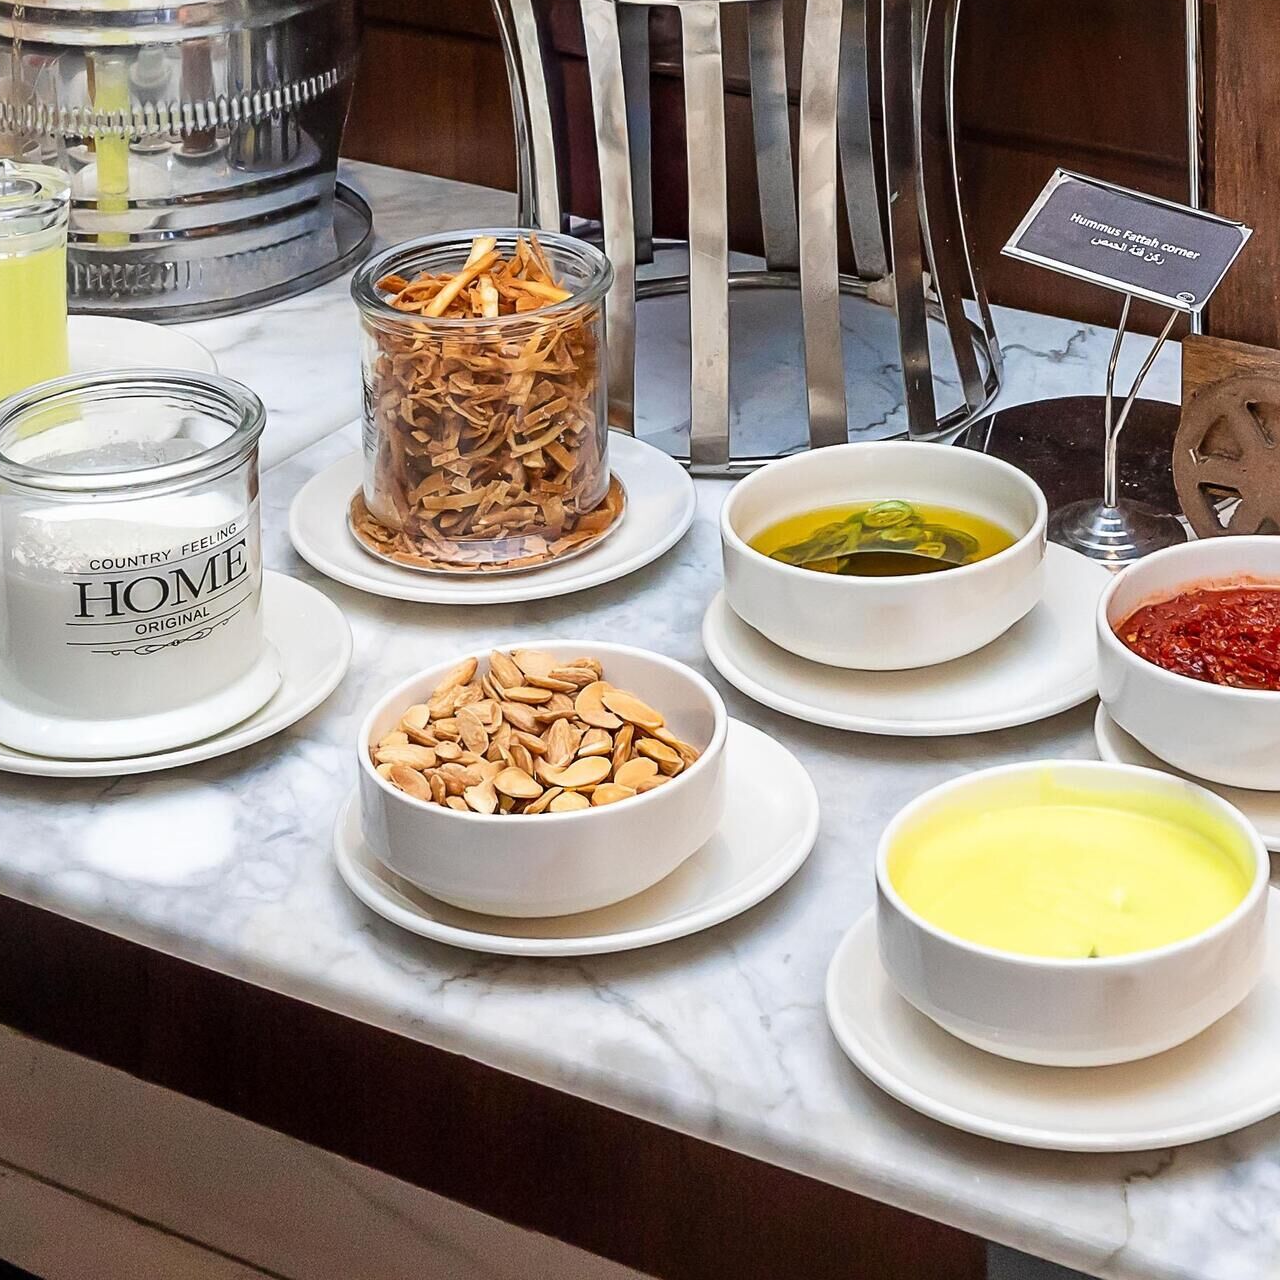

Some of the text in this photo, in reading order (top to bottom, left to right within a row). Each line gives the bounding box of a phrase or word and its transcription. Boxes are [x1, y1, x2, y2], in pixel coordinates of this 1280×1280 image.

[1070, 212, 1201, 260] Hummus Fattah corner
[1090, 237, 1165, 265] ركن فتة الحمص
[89, 522, 237, 571] COUNTRY FEELING
[73, 538, 249, 619] HOME
[134, 605, 211, 636] ORIGINAL
